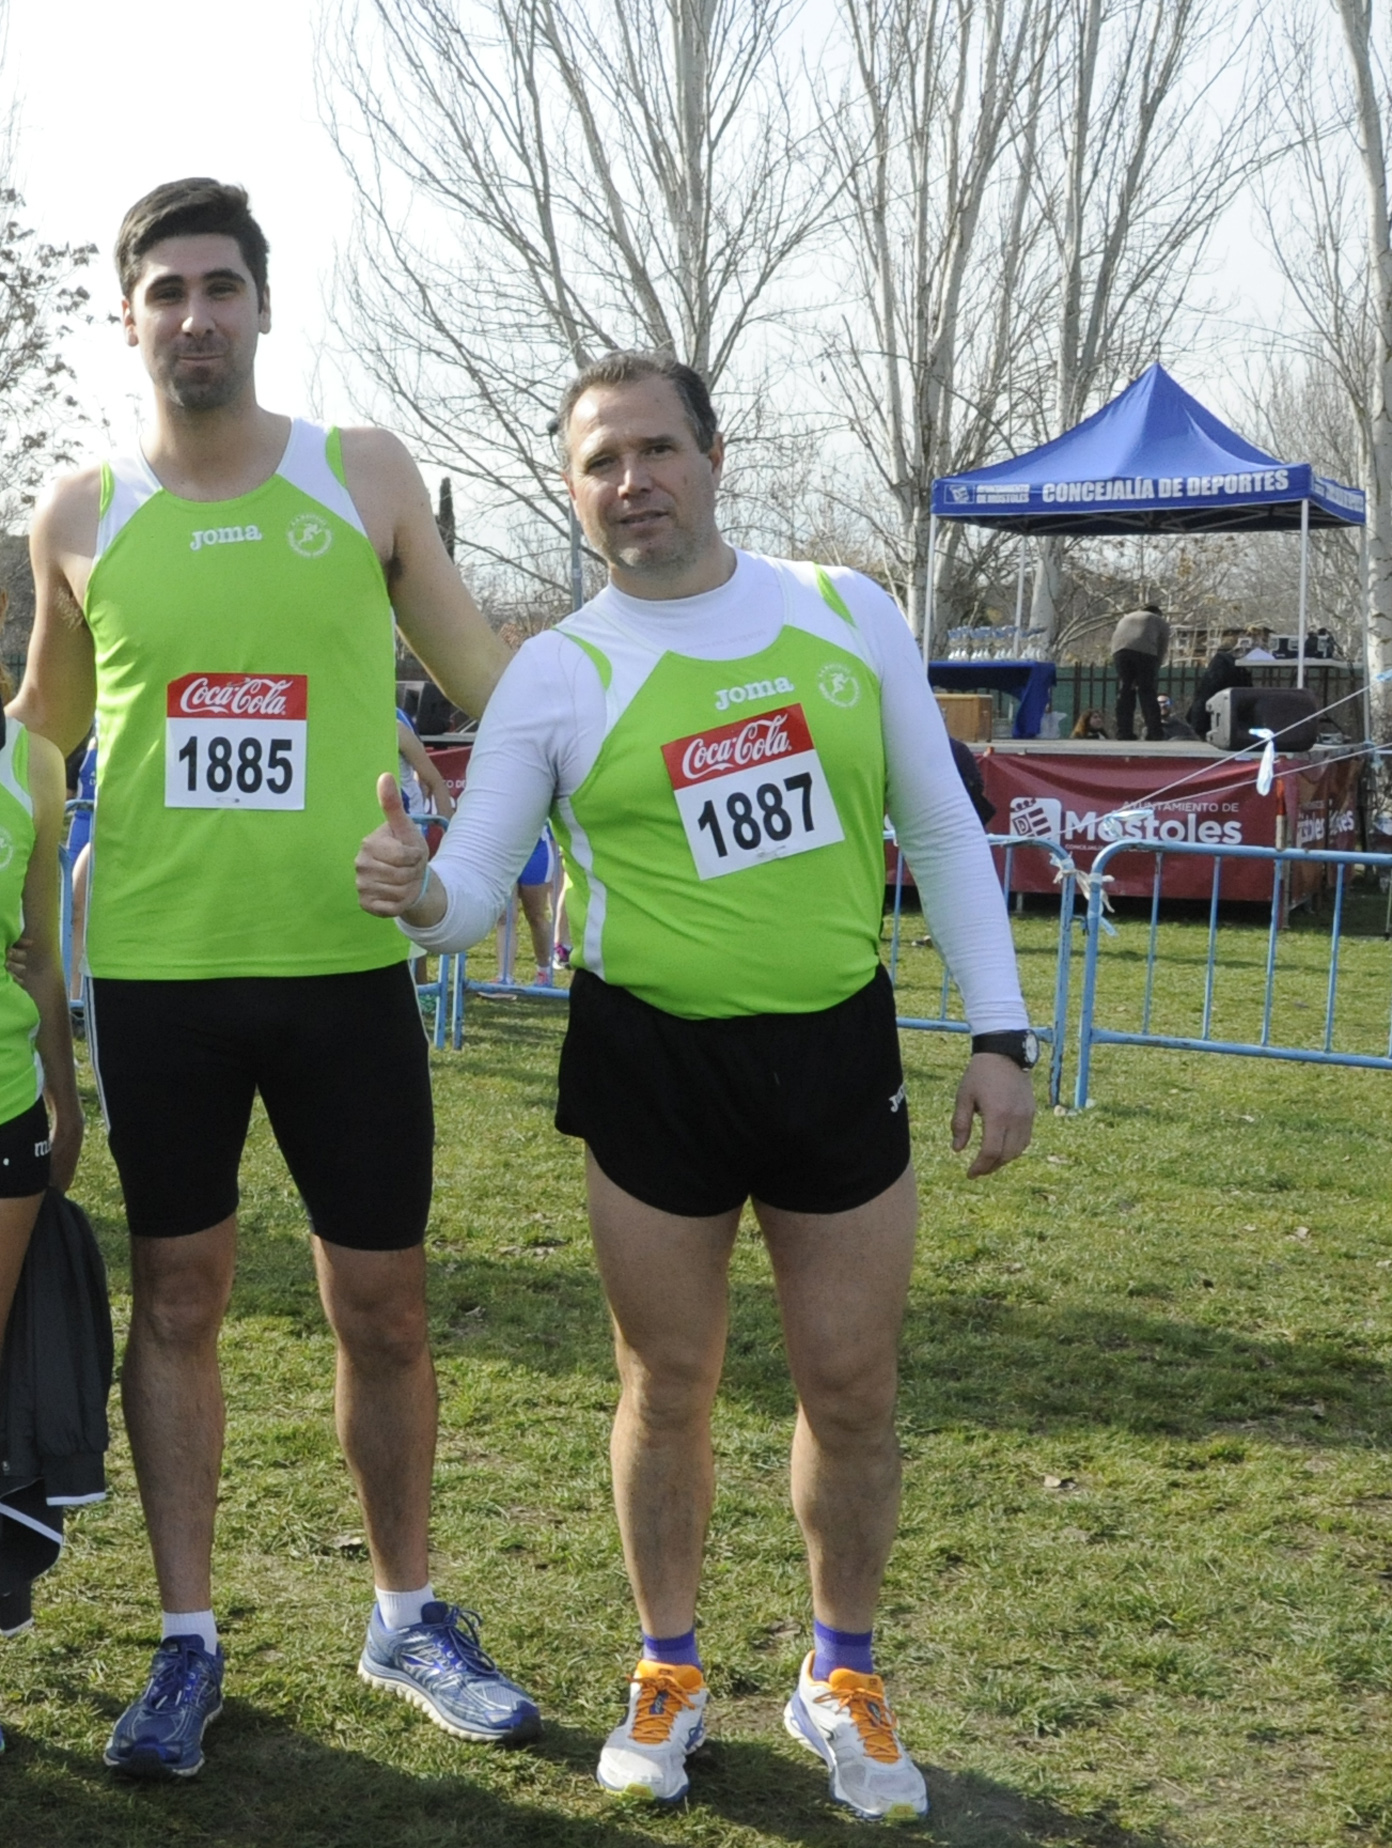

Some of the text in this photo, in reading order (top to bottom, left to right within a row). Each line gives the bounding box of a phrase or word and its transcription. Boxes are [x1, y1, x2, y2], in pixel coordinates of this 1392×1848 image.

[1042, 469, 1289, 503] CONCEJALÍA DE DEPORTES
[190, 524, 263, 551] Joma
[179, 676, 294, 716] Coca-Cola
[714, 676, 795, 711] Joma
[178, 736, 294, 794] 1885
[681, 713, 790, 780] Coca-Cola
[697, 771, 815, 858] 1887
[1221, 802, 1240, 813] DE
